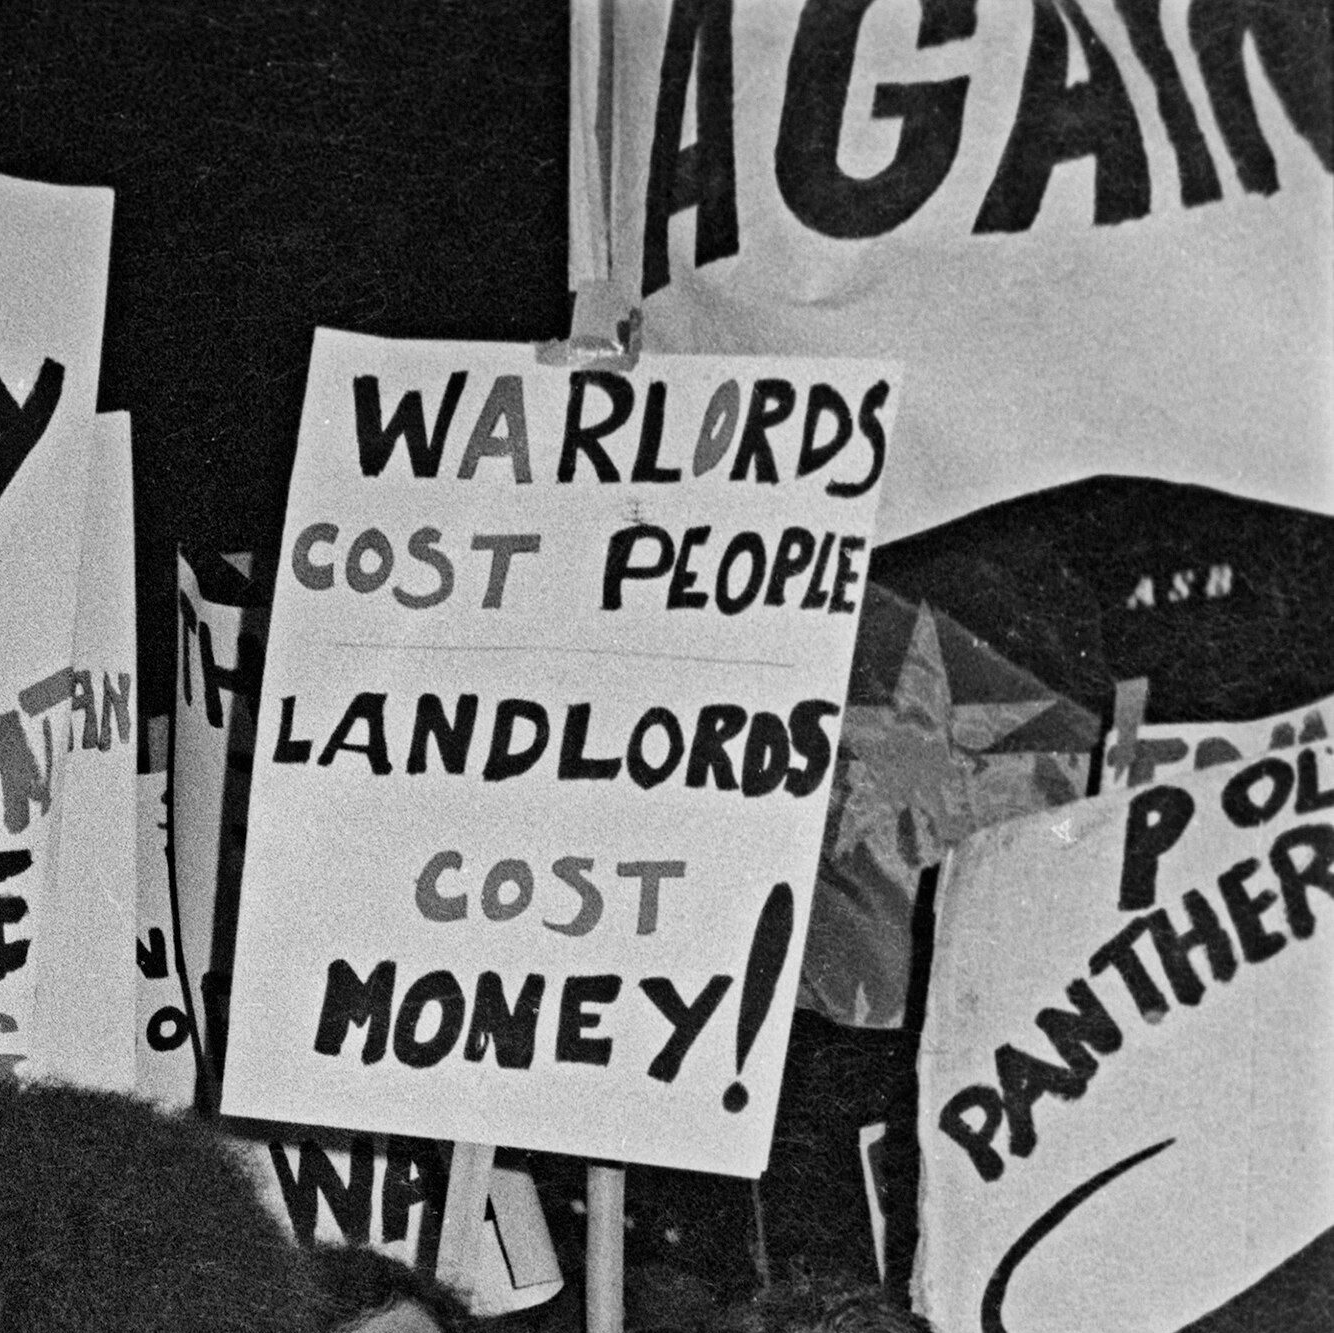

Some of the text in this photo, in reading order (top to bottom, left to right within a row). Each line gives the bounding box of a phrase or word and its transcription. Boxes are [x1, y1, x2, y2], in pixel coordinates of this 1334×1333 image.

[351, 370, 890, 498] WARLORDS
[290, 523, 866, 616] COST PEOPLE
[270, 692, 841, 798] LANDLORDS
[414, 850, 687, 938] COST
[313, 882, 795, 1114] MONEY!
